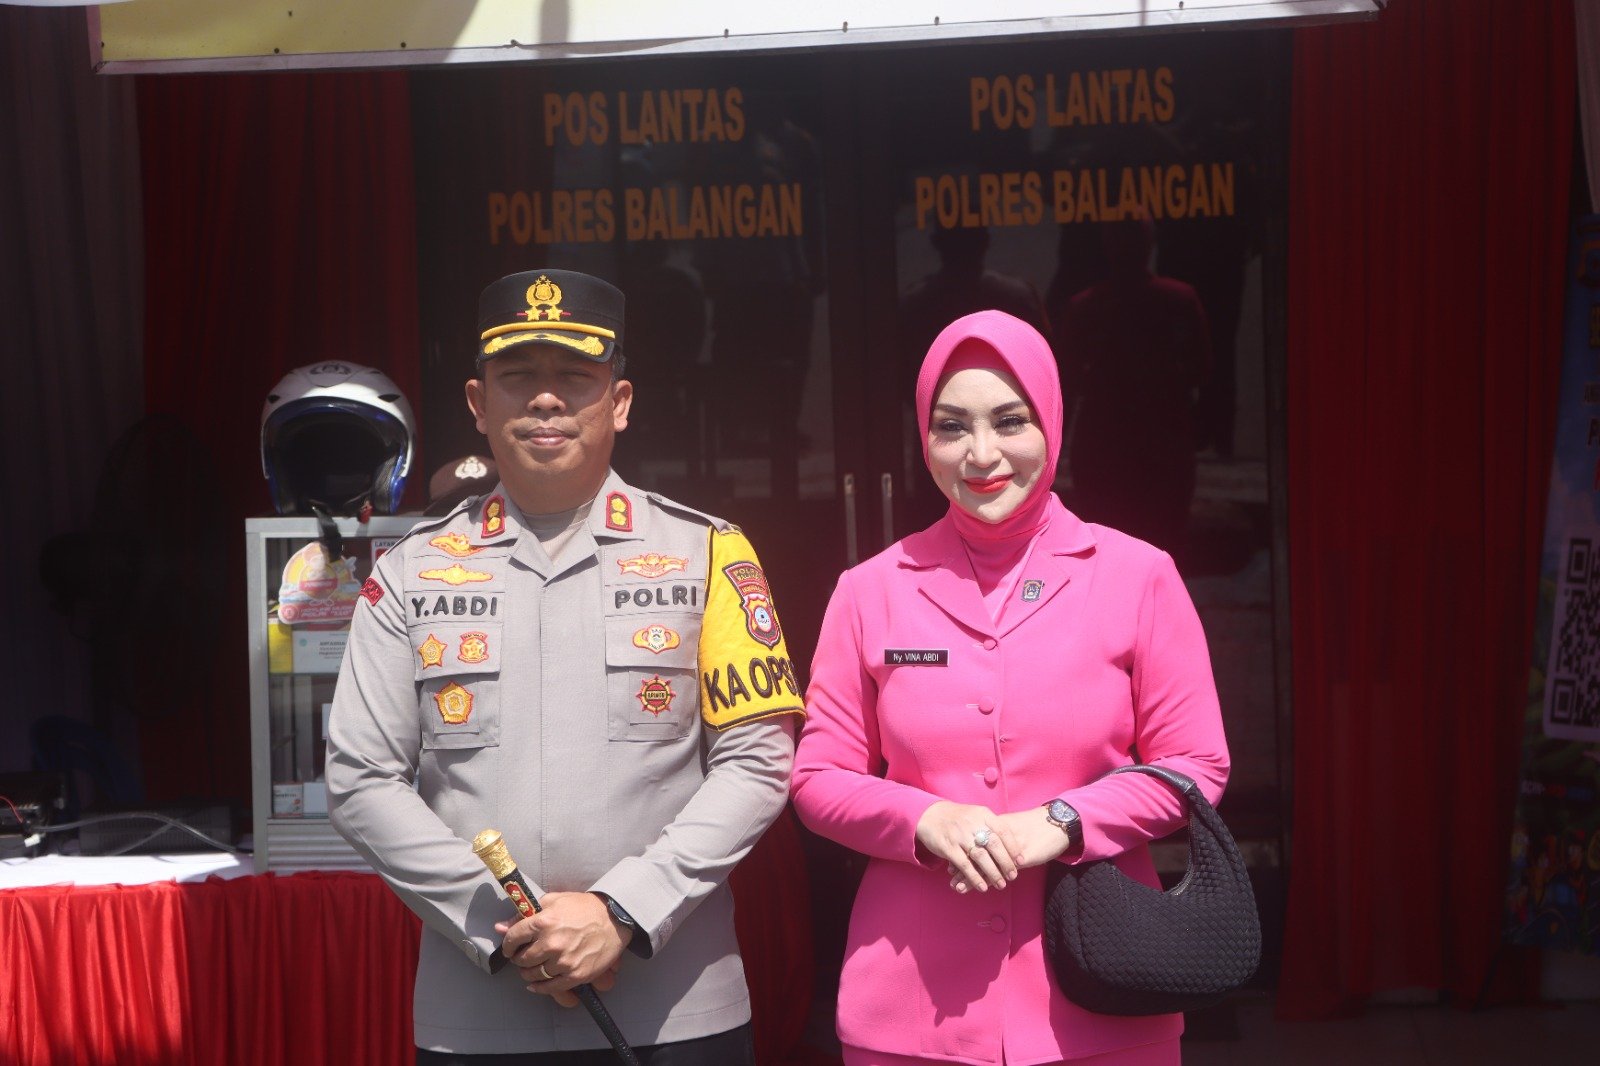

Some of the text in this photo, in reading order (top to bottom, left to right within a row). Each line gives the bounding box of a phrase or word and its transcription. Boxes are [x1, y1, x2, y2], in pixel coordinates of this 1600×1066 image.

[543, 87, 746, 147] POS LANTAS
[970, 67, 1176, 132] POS LANTAS
[488, 182, 804, 245] POLRES BALANGAN
[915, 162, 1236, 230] POLRES BALANGAN
[411, 595, 498, 618] Y.ABDI
[614, 585, 697, 609] POLRI
[704, 655, 802, 712] KA OPS
[893, 653, 939, 663] Ny. VINA ABDI
